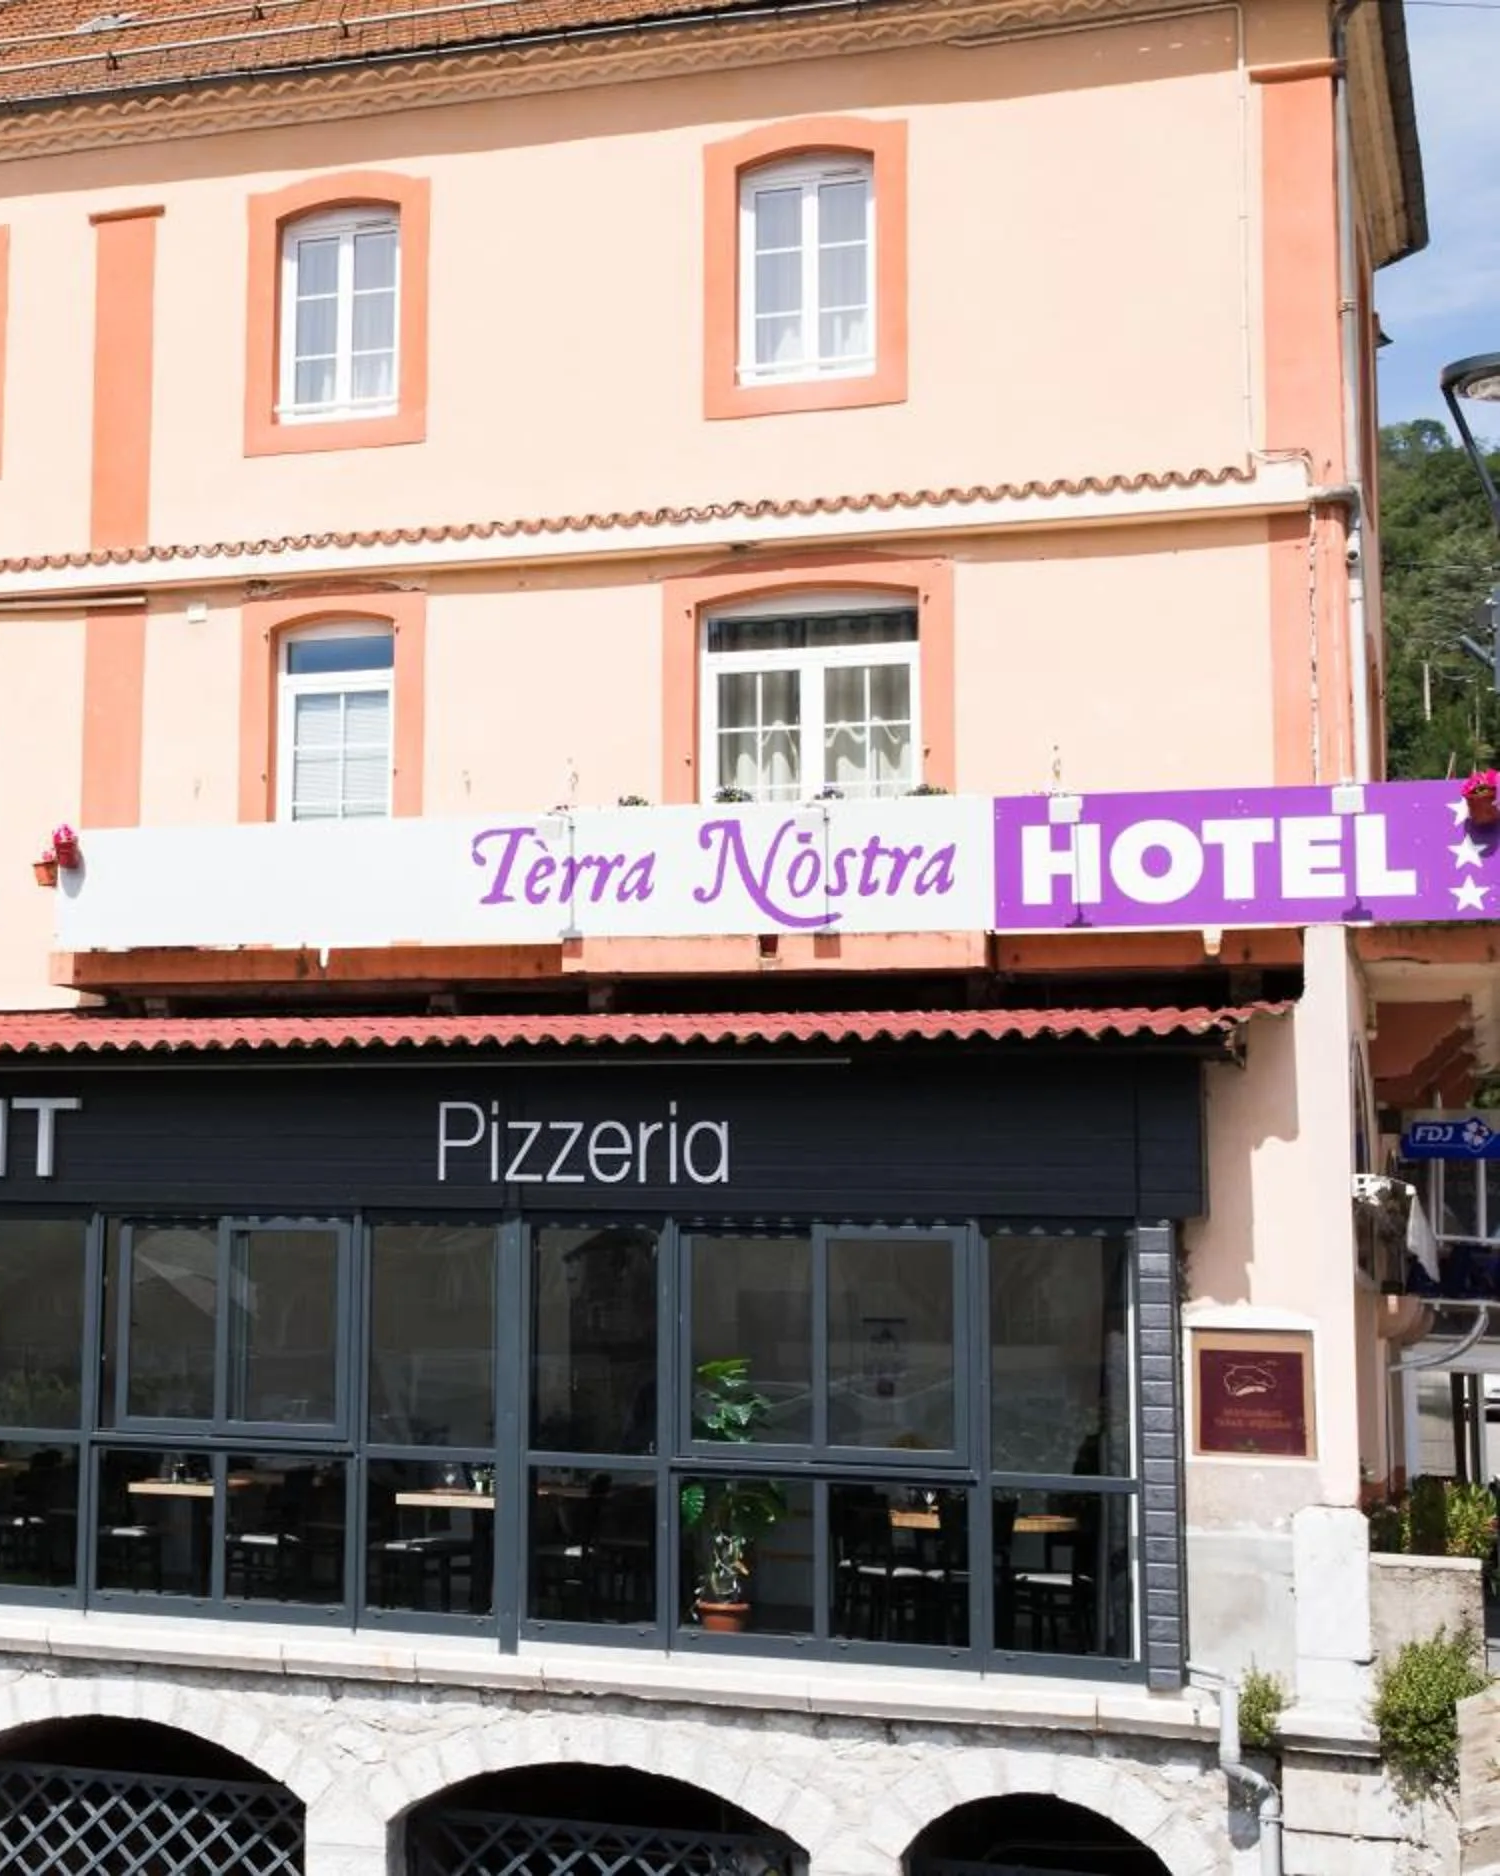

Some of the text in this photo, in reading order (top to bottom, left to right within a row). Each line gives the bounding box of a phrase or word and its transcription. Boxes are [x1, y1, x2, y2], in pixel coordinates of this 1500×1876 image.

[1019, 813, 1417, 904] HOTEL
[436, 1099, 732, 1184] Pizzeria
[1415, 1125, 1454, 1142] FDJ
